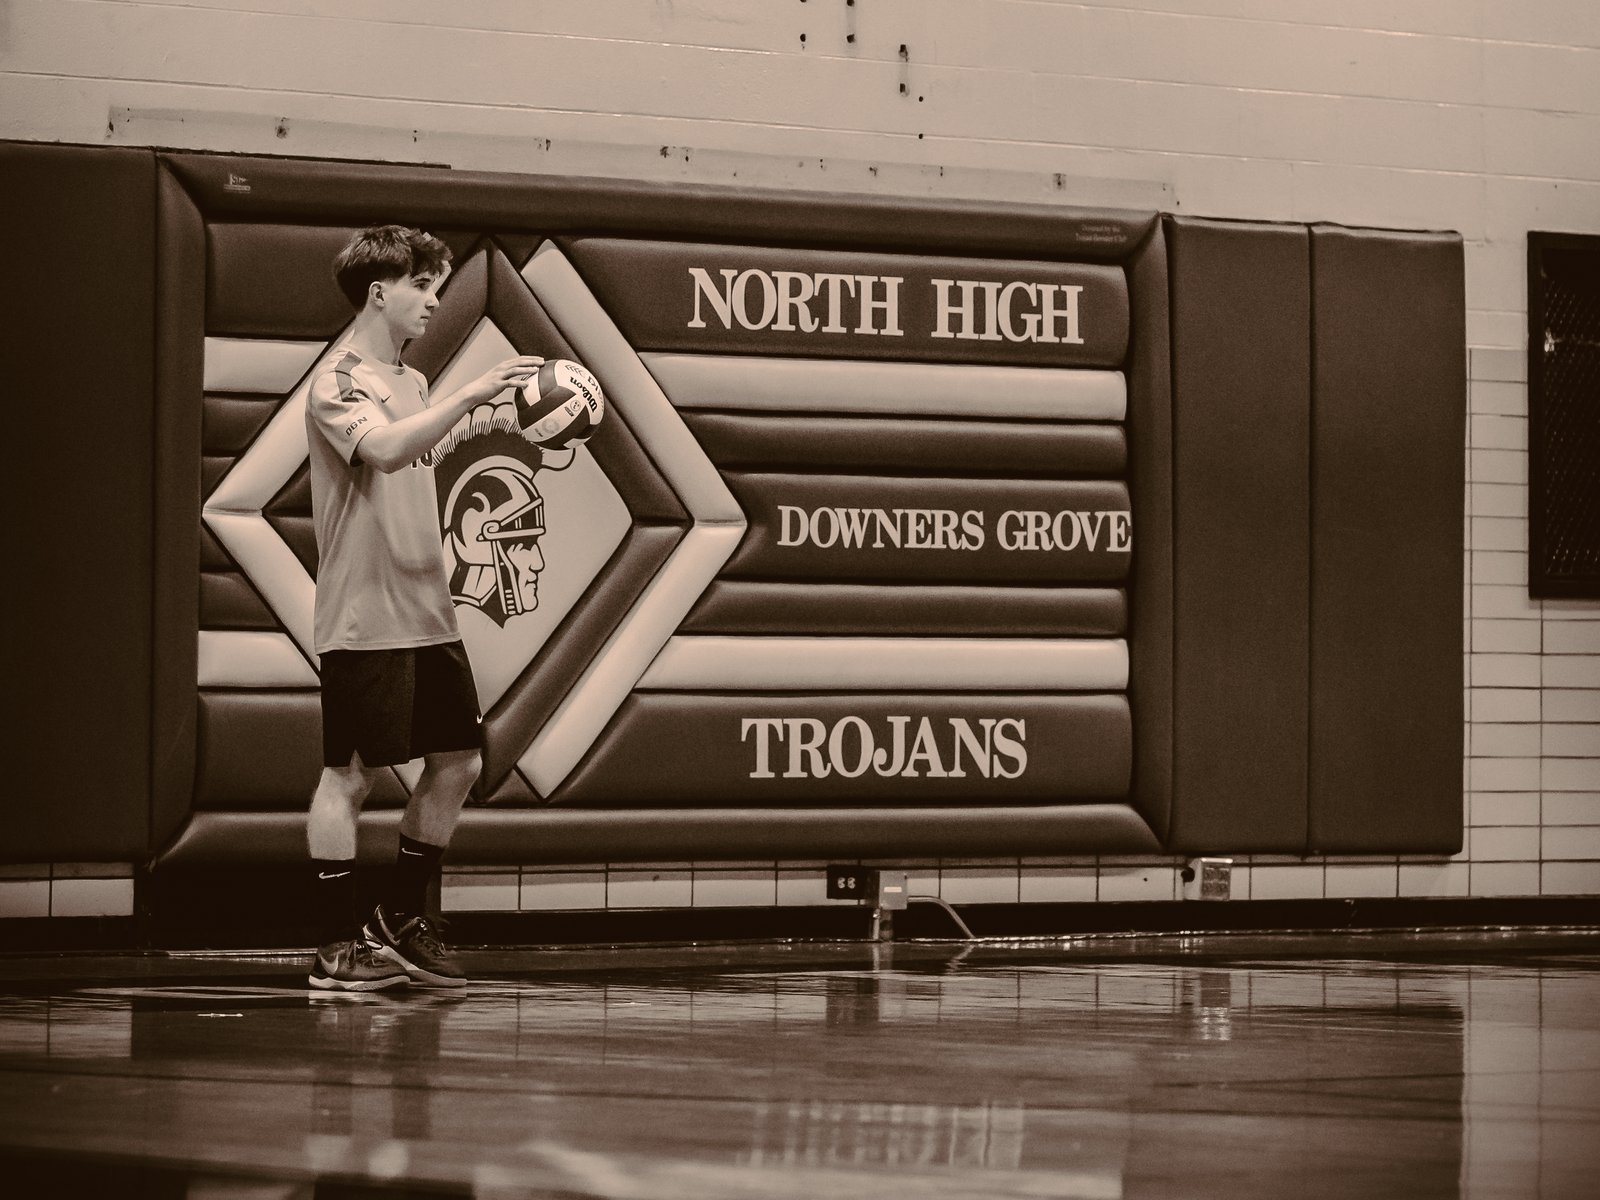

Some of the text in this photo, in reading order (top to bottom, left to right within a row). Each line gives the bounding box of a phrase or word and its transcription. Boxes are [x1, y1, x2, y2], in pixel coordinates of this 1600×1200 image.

[687, 266, 1084, 345] NORTH HIGH
[569, 376, 598, 413] Wilson
[776, 504, 1132, 554] DOWNERS GROVE
[741, 715, 1029, 780] TROJANS
